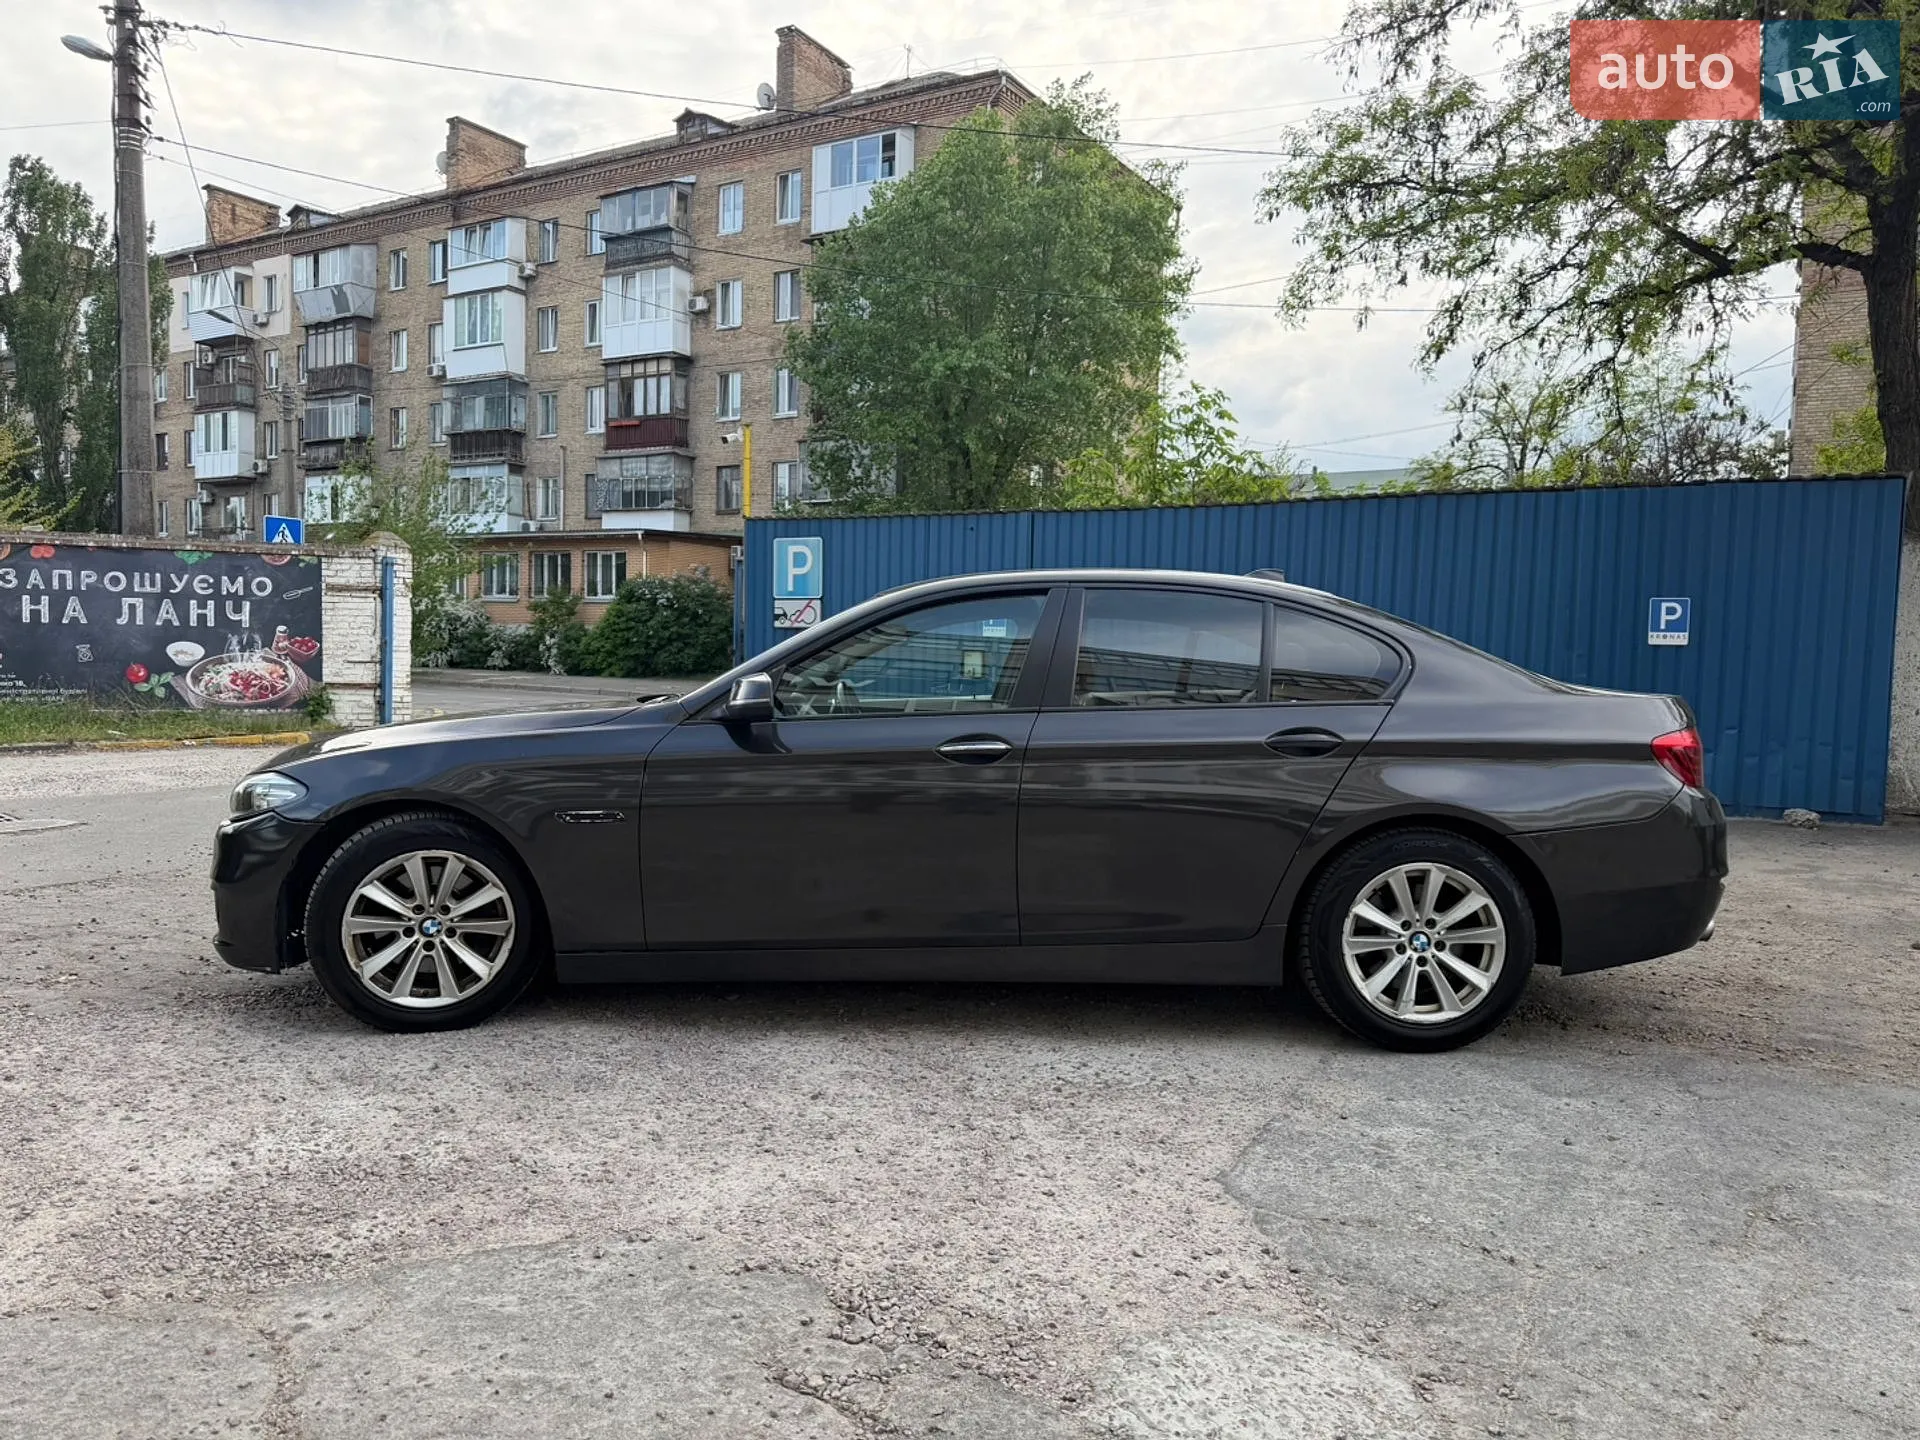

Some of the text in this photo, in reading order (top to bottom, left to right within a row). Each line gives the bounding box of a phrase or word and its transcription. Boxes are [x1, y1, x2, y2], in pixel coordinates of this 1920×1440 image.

[0, 567, 274, 598] ЗАПРОШУЄМО
[787, 545, 813, 592] P
[21, 594, 251, 628] НА ЛАНЧ
[1660, 602, 1683, 630] P
